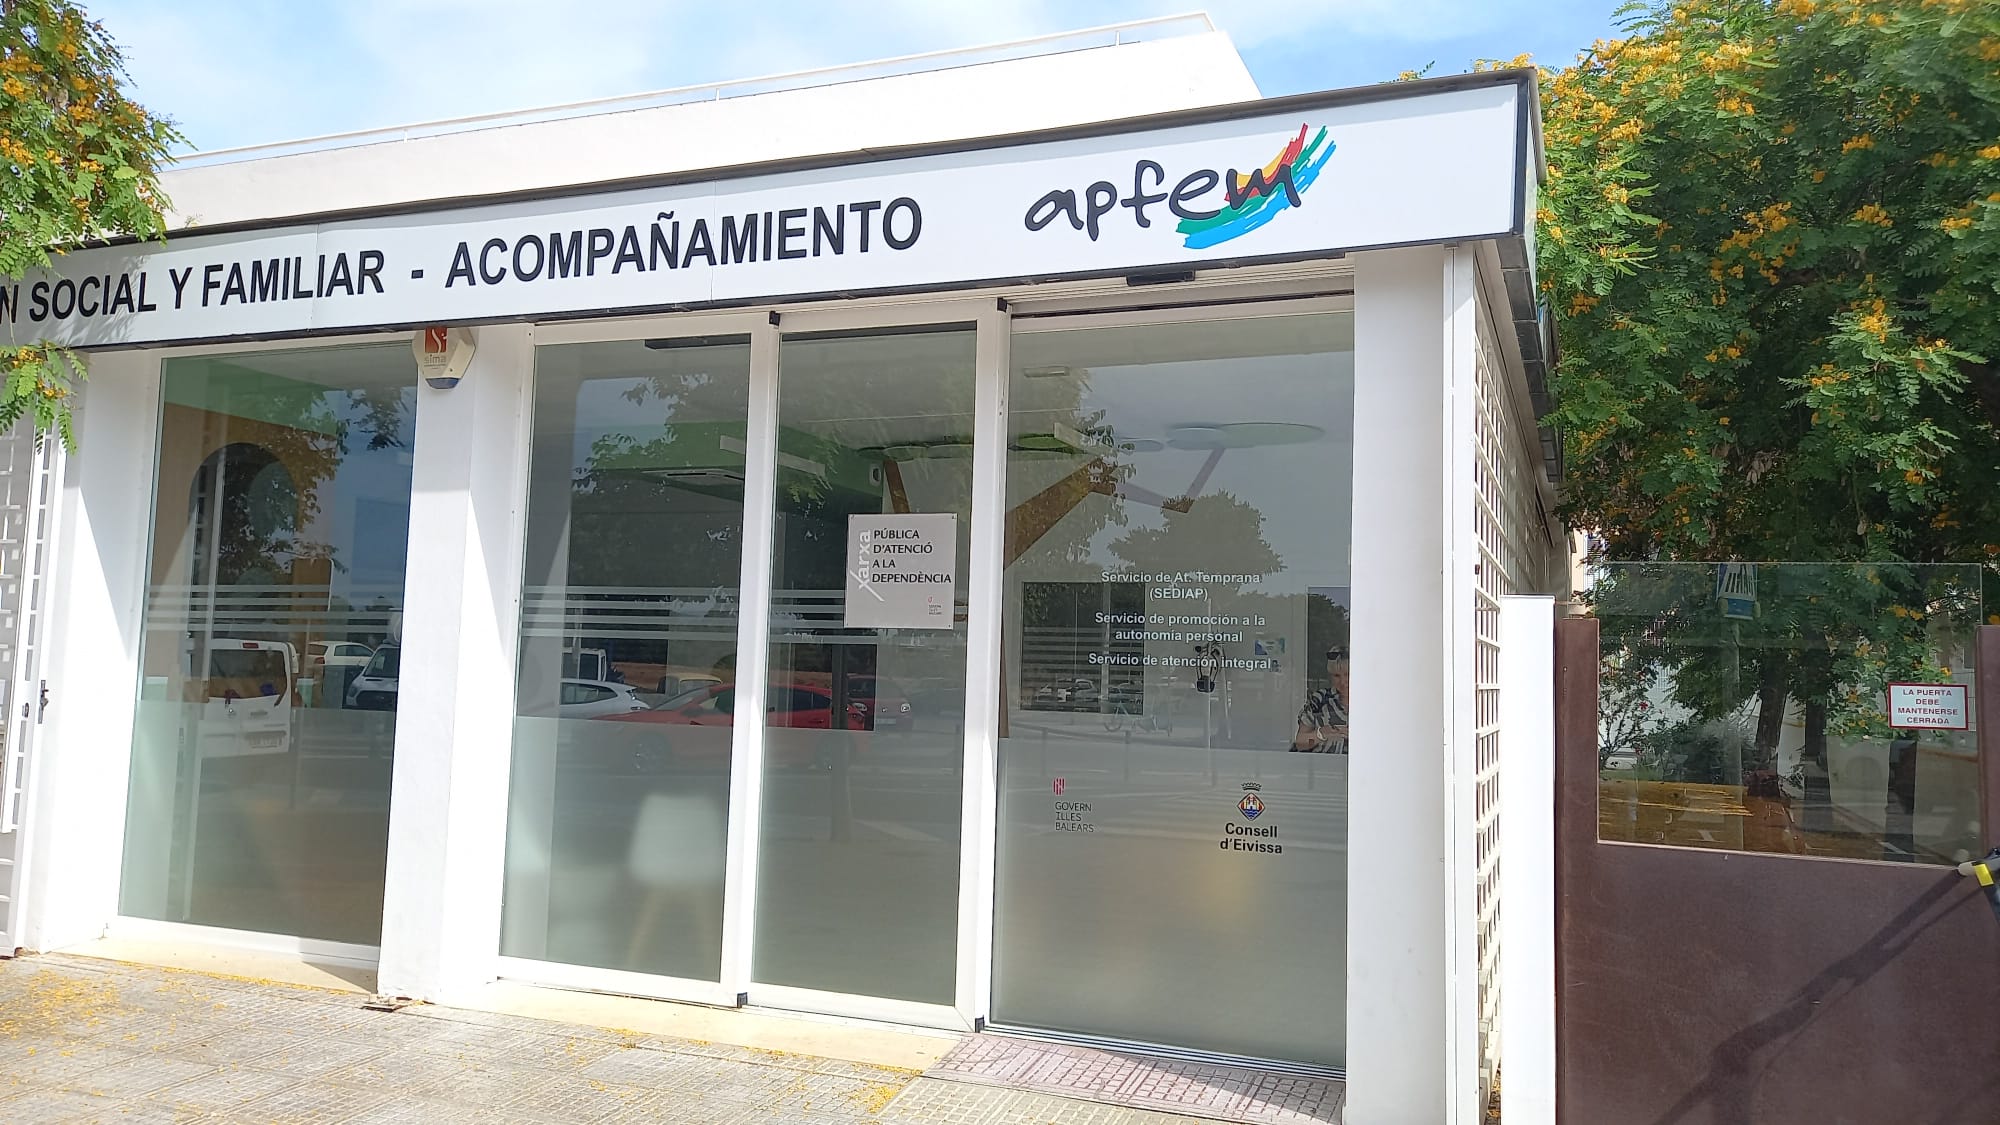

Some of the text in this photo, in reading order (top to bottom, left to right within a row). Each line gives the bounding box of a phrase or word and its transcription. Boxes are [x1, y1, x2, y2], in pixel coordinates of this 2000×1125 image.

[1024, 159, 1302, 242] apfem
[29, 271, 157, 322] SOCIAL
[169, 266, 193, 309] Y
[202, 249, 386, 307] FAMILIAR
[445, 196, 923, 289] ACOMPAÑAMIENTO
[873, 527, 920, 539] PÚBLICA
[873, 541, 933, 554] D'ATENCIÓ
[872, 559, 896, 568] A LA
[872, 571, 952, 583] DEPENDÈNCIA
[1101, 571, 1260, 585] Servicio de At. Temprana
[1149, 587, 1208, 601] (SEDIAP)
[1095, 612, 1265, 626] Servicio de promoción a la
[1115, 629, 1243, 643] autonomía personal
[1088, 653, 1271, 671] Servicio de atención integral
[1917, 689, 1952, 697] PUERTA
[1915, 698, 1940, 706] DEBE
[1898, 707, 1959, 716] MANTENERSE
[1055, 801, 1092, 812] GOVERN
[1056, 812, 1082, 822] ILLES
[1055, 822, 1095, 833] BALEARS
[1224, 822, 1278, 838] Consell
[1219, 838, 1283, 854] d'Eivissa
